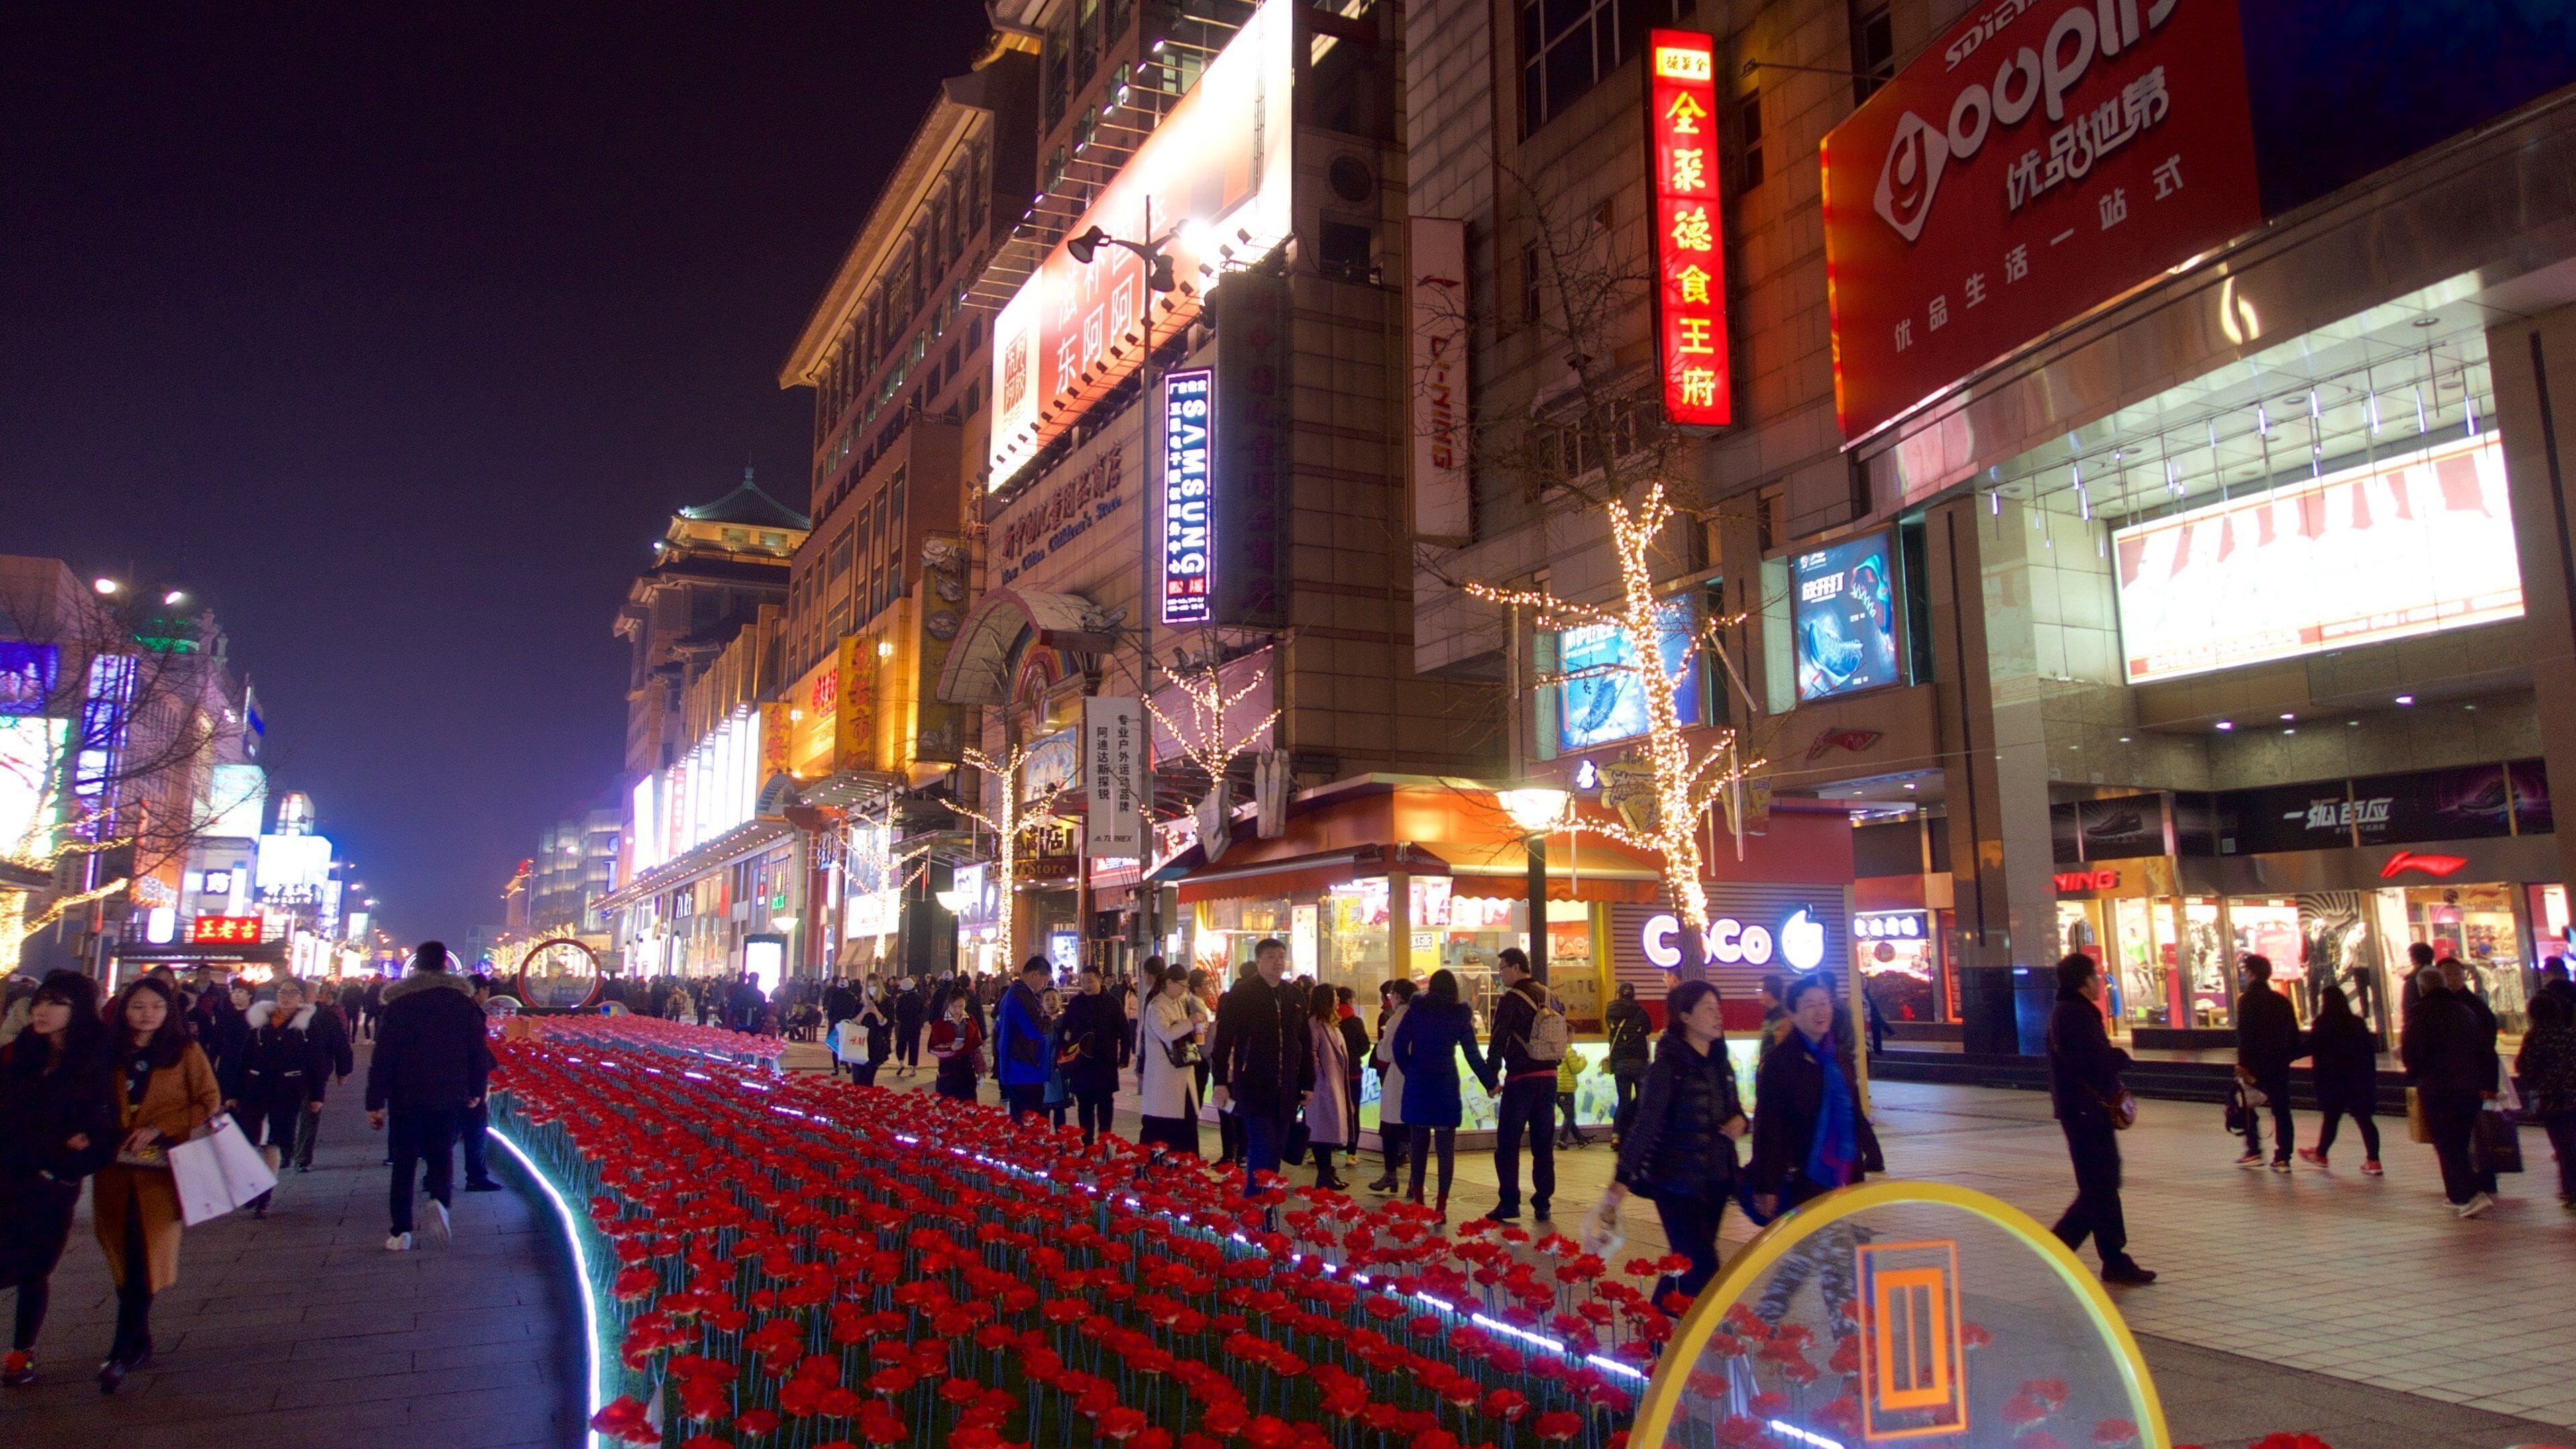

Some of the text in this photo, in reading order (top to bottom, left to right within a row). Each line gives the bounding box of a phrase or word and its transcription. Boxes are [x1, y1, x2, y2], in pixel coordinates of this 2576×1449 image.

[1894, 154, 2184, 353] 优品生活一站式
[1181, 399, 1206, 574] SAMSUNG
[1097, 727, 1110, 800] 阿迪达斯探锐
[1117, 714, 1130, 813] 专业户外运动品牌
[197, 920, 257, 938] 王老吉
[1643, 914, 1772, 967] CCo
